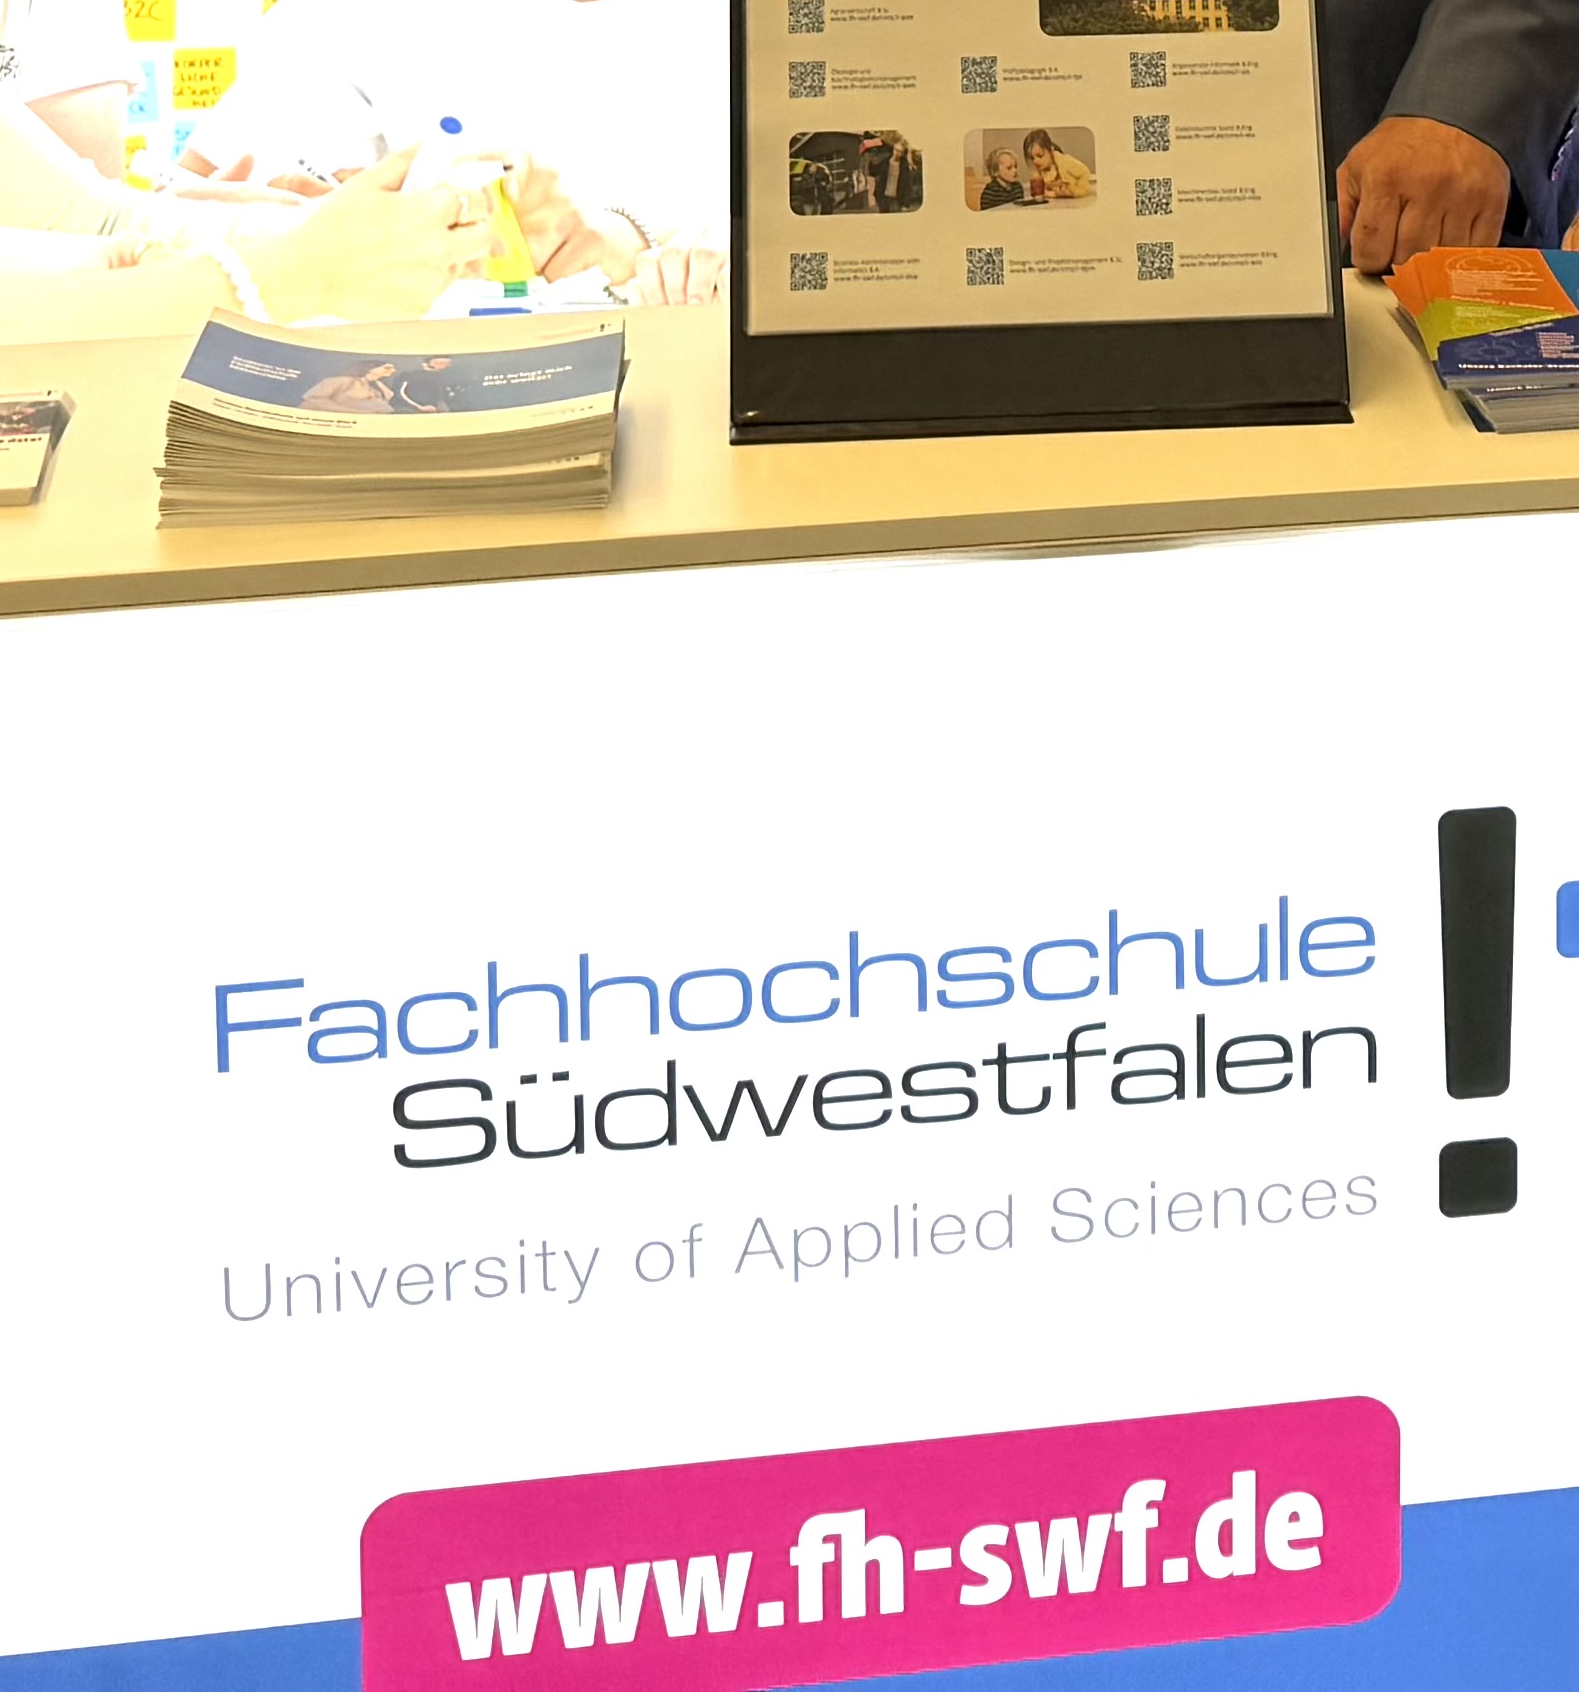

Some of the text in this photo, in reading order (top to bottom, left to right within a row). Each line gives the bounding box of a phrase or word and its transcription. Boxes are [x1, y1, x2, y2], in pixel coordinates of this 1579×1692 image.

[215, 894, 1377, 1073] Fachhochschule
[392, 1012, 1378, 1170] Südwestfalen
[222, 1173, 1379, 1322] University of Applied Sciences
[445, 1469, 1325, 1661] www.fh-swf.de
